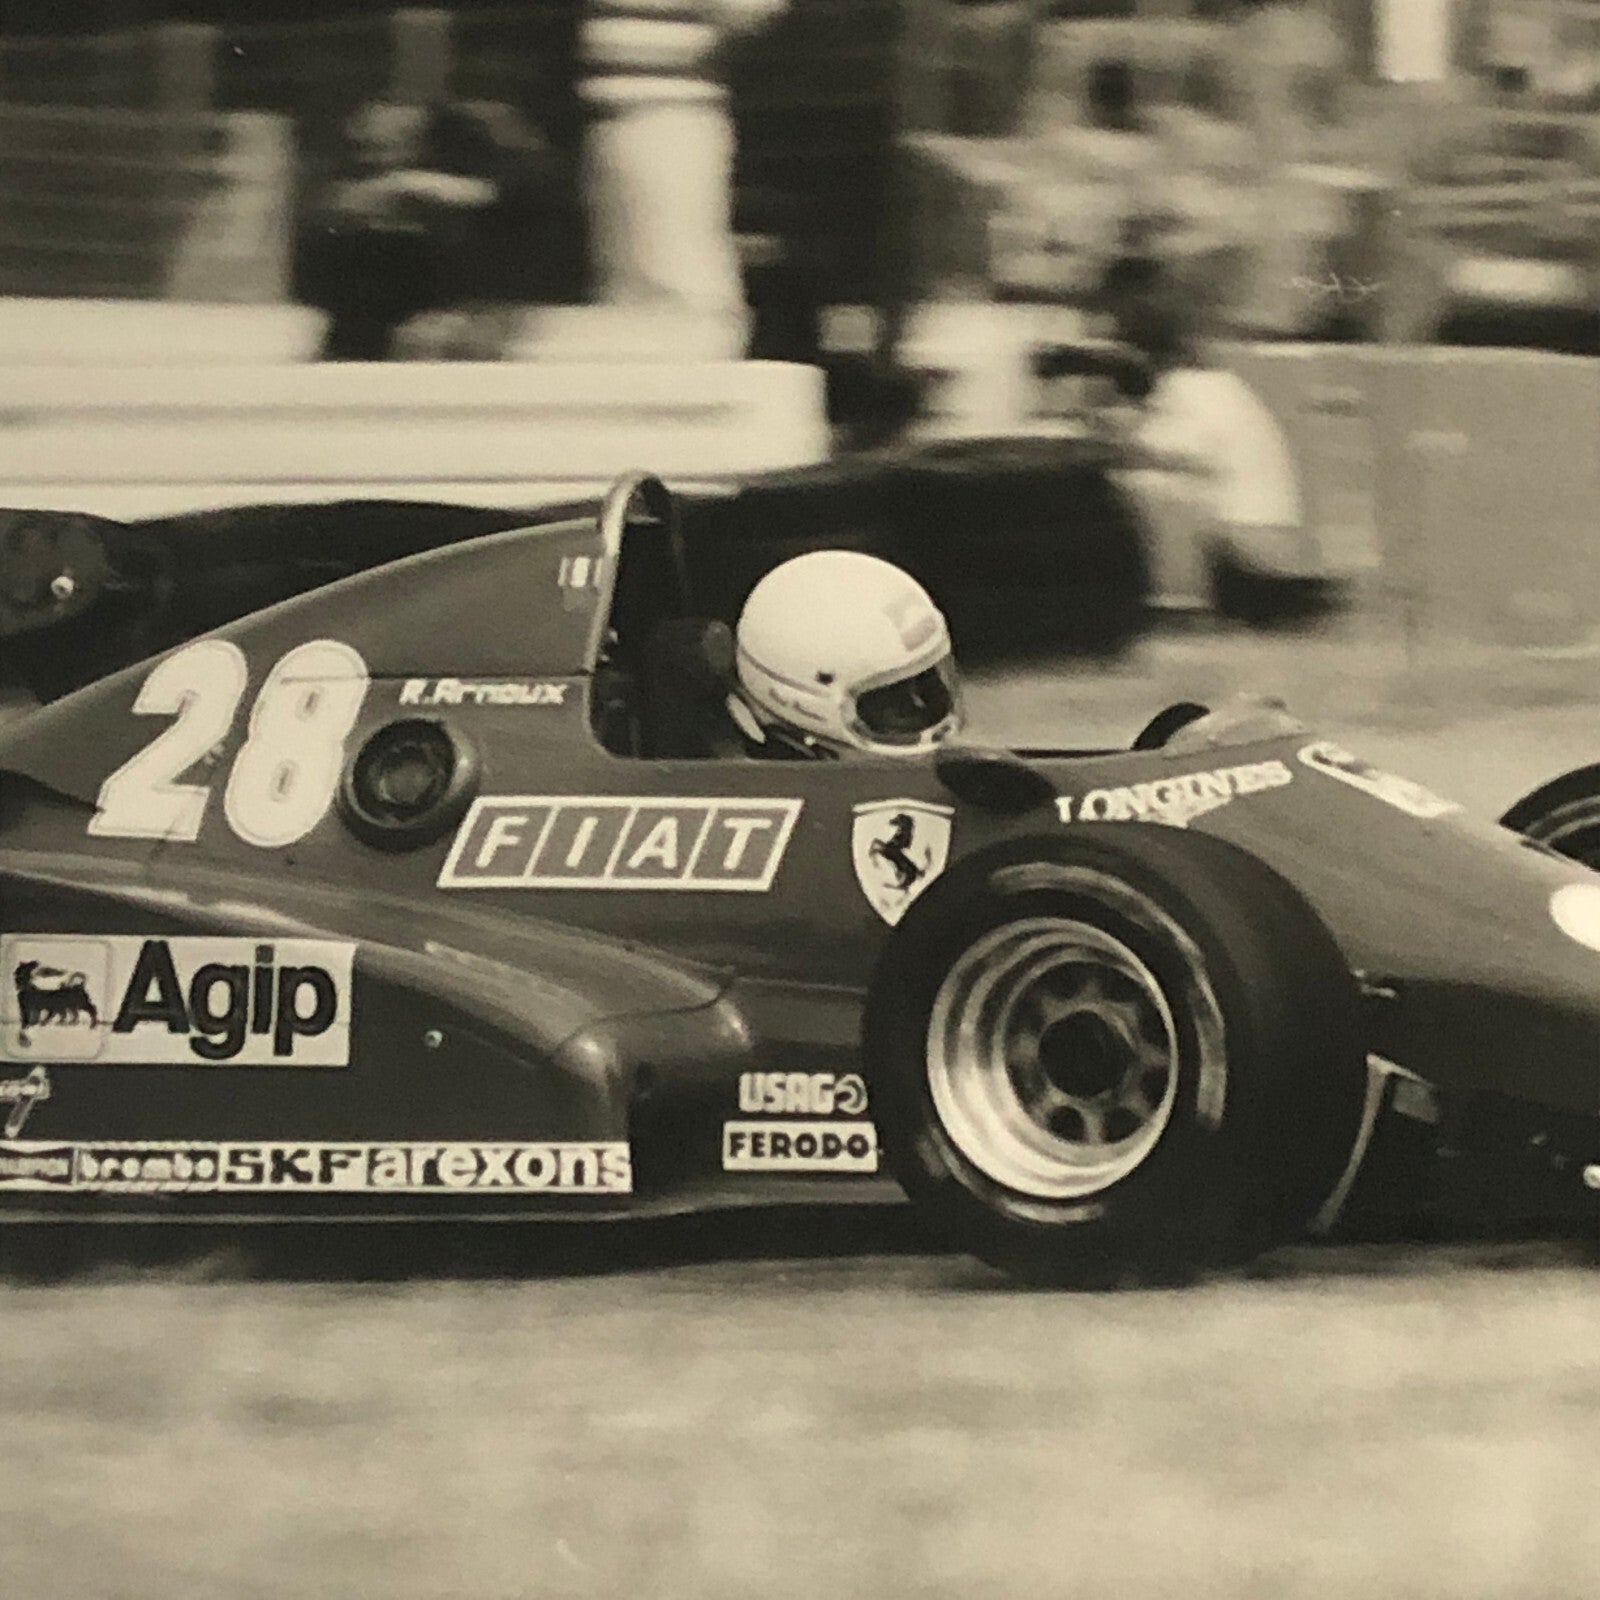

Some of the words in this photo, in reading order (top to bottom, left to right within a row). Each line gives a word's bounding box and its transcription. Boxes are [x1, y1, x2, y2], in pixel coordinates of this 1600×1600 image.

[87, 639, 369, 848] 28
[476, 816, 773, 870] FIAT
[112, 940, 337, 1060] Agip
[739, 1072, 835, 1114] USAG
[226, 1149, 361, 1184] SKF
[729, 1132, 869, 1159] FERODO
[371, 1149, 631, 1187] arexons
